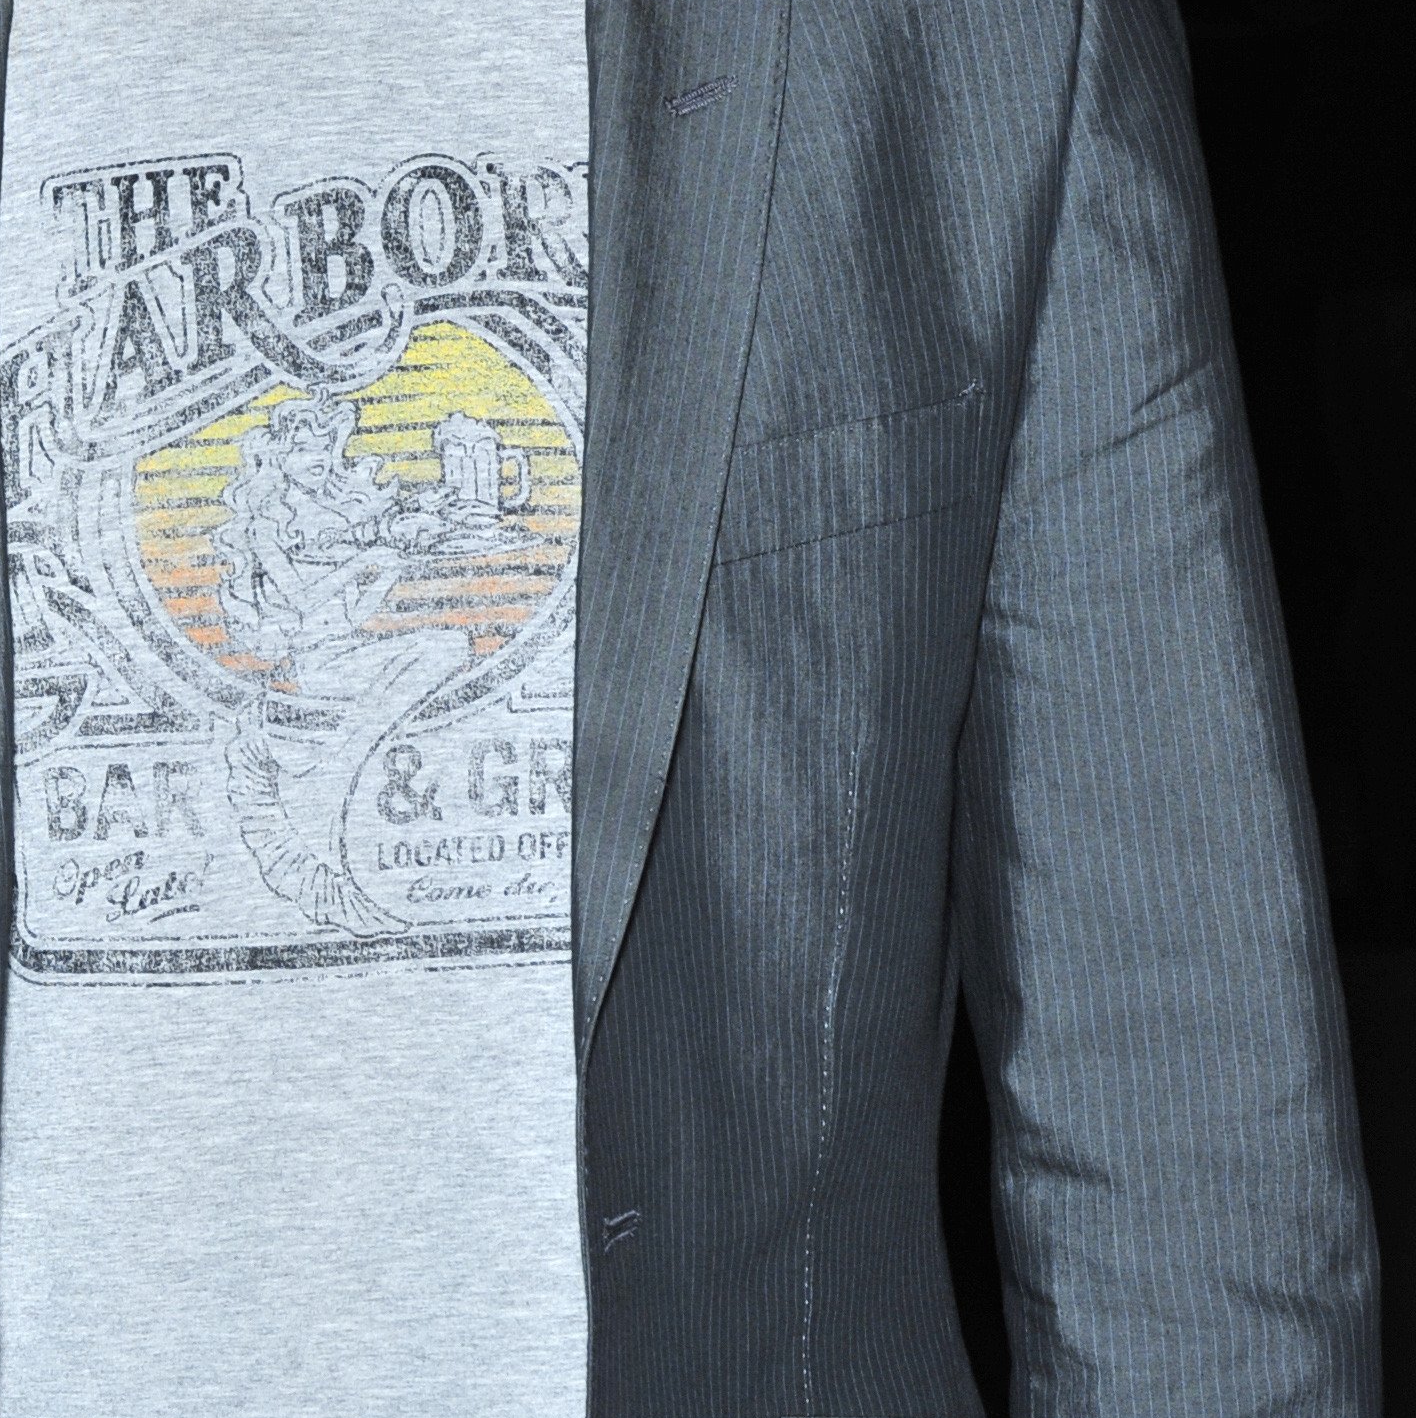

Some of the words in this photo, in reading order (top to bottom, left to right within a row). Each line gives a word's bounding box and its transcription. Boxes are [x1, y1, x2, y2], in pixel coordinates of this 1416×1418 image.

[51, 163, 237, 298] THE
[42, 760, 206, 841] BAR
[377, 743, 443, 825] &
[52, 849, 150, 907] Open
[377, 834, 506, 871] LOCATED
